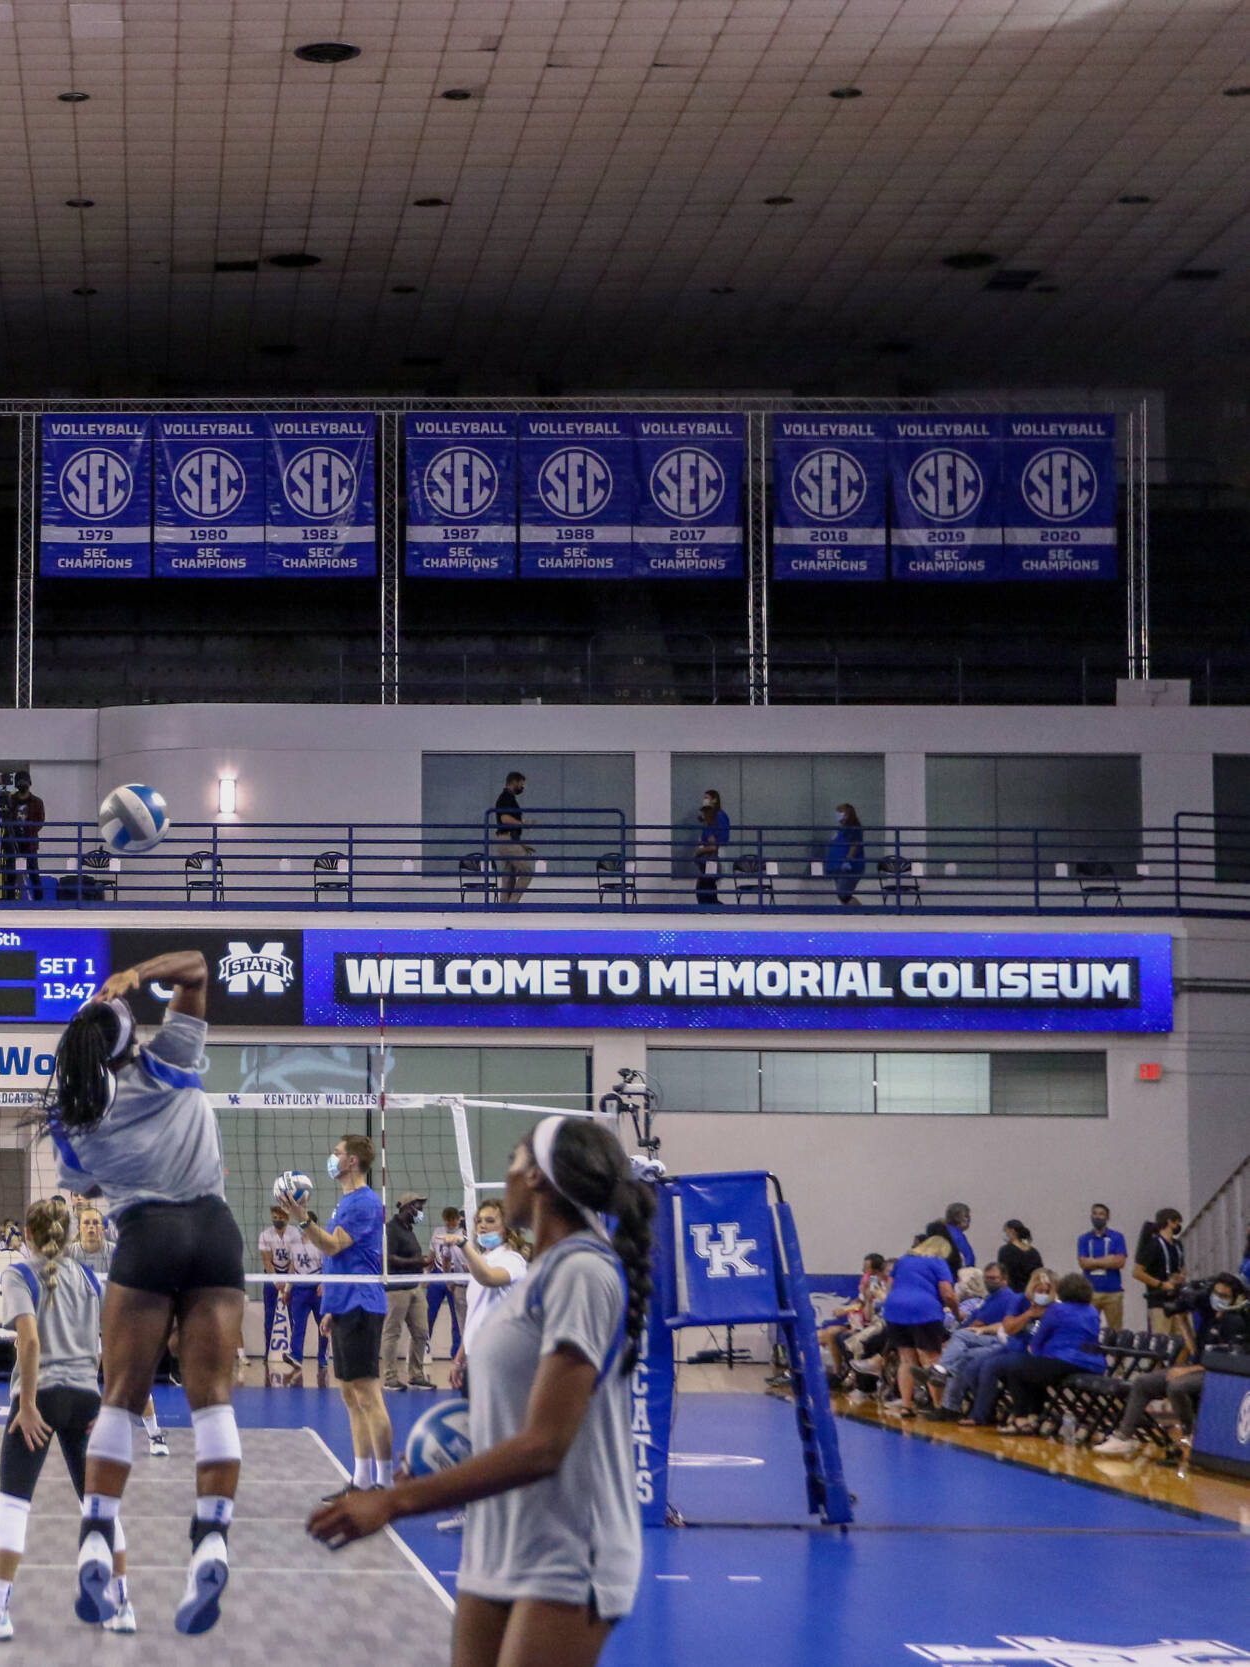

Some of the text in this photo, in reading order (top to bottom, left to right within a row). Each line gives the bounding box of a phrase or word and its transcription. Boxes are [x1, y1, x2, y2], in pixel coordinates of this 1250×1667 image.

[52, 424, 141, 435] VOLLEYBALL
[164, 424, 253, 434] VOLLEYBALL
[275, 423, 365, 434] VOLLEYBALL
[416, 423, 506, 433] VOLLEYBALL
[530, 423, 620, 434] VOLLEYBALL
[642, 423, 732, 434] VOLLEYBALL
[783, 424, 874, 435] VOLLEYBALL
[898, 424, 989, 436] VOLLEYBALL
[1013, 424, 1105, 435] VOLLEYBALL
[67, 454, 125, 515] SEC
[180, 454, 238, 515] SEC
[291, 453, 349, 514] SEC
[432, 452, 491, 514] SEC
[545, 453, 605, 514] SEC
[657, 453, 717, 514] SEC
[799, 455, 859, 515] SEC
[914, 455, 975, 516] SEC
[1028, 455, 1089, 516] SEC
[78, 530, 113, 540] 1979
[190, 530, 227, 540] 1980
[302, 529, 338, 540] 1983
[443, 529, 478, 539] 1987
[557, 529, 594, 539] 1988
[670, 530, 705, 540] 2017
[810, 531, 848, 542] 2018
[928, 531, 965, 542] 2019
[1041, 531, 1080, 541] 2020
[84, 549, 106, 557] SEC
[198, 548, 220, 557] SEC
[309, 548, 331, 557] SEC
[449, 548, 472, 556] SEC
[564, 548, 587, 557] SEC
[676, 549, 699, 558] SEC
[818, 549, 840, 559] SEC
[935, 551, 958, 560] SEC
[1048, 550, 1072, 560] SEC
[58, 559, 132, 568] CHAMPIONS
[172, 559, 246, 568] CHAMPIONS
[283, 559, 357, 568] CHAMPIONS
[423, 558, 498, 568] CHAMPIONS
[538, 558, 613, 568] CHAMPIONS
[651, 559, 725, 568] CHAMPIONS
[791, 560, 867, 570] CHAMPIONS
[909, 561, 984, 571] CHAMPIONS
[1023, 560, 1098, 570] CHAMPIONS
[40, 958, 95, 974] SET 1
[232, 959, 281, 974] STATE
[346, 959, 1129, 998] WELCOME TO MEMORIAL COLISEUM
[43, 984, 95, 998] 13:47
[264, 1094, 377, 1105] KENTUCKY WILDCATS
[690, 1222, 759, 1279] UK
